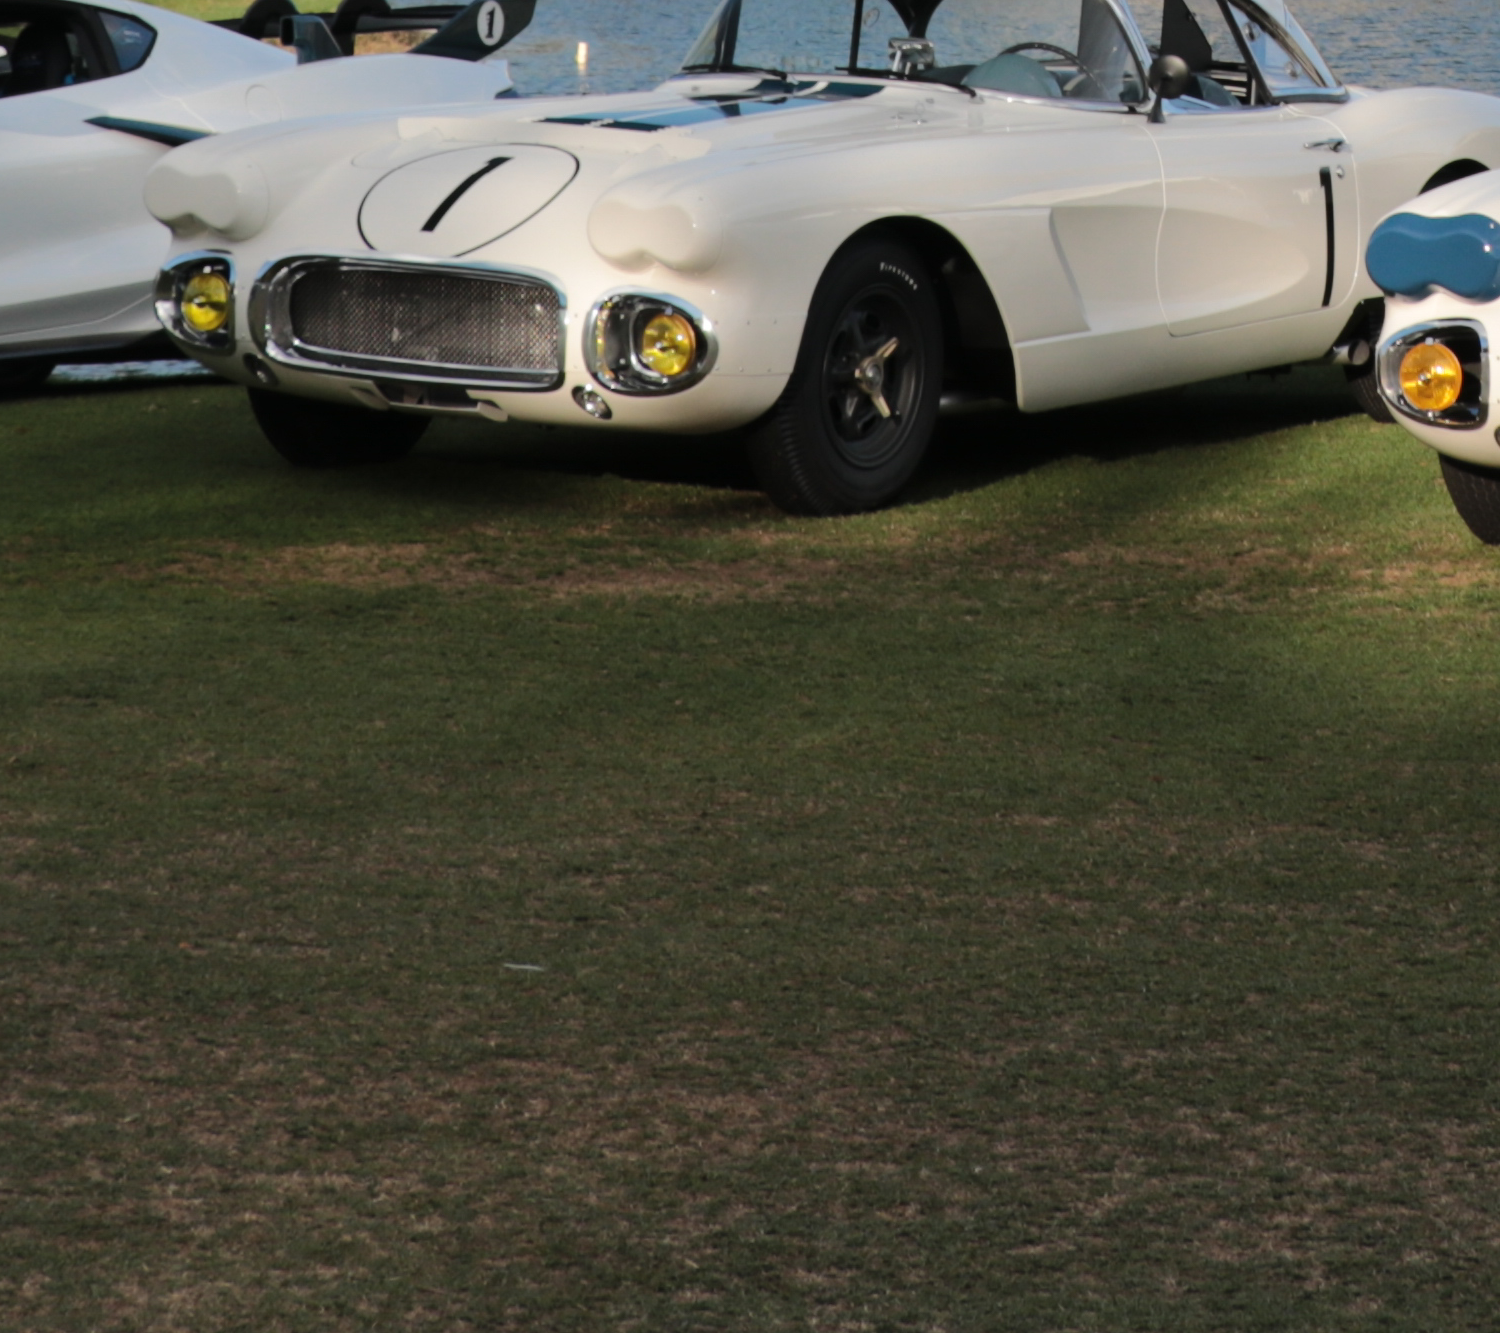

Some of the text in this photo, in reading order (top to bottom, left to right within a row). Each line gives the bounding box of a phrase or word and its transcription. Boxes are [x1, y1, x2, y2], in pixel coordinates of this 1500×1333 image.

[485, 6, 495, 39] 1
[420, 156, 514, 232] 1
[1319, 166, 1335, 307] 1
